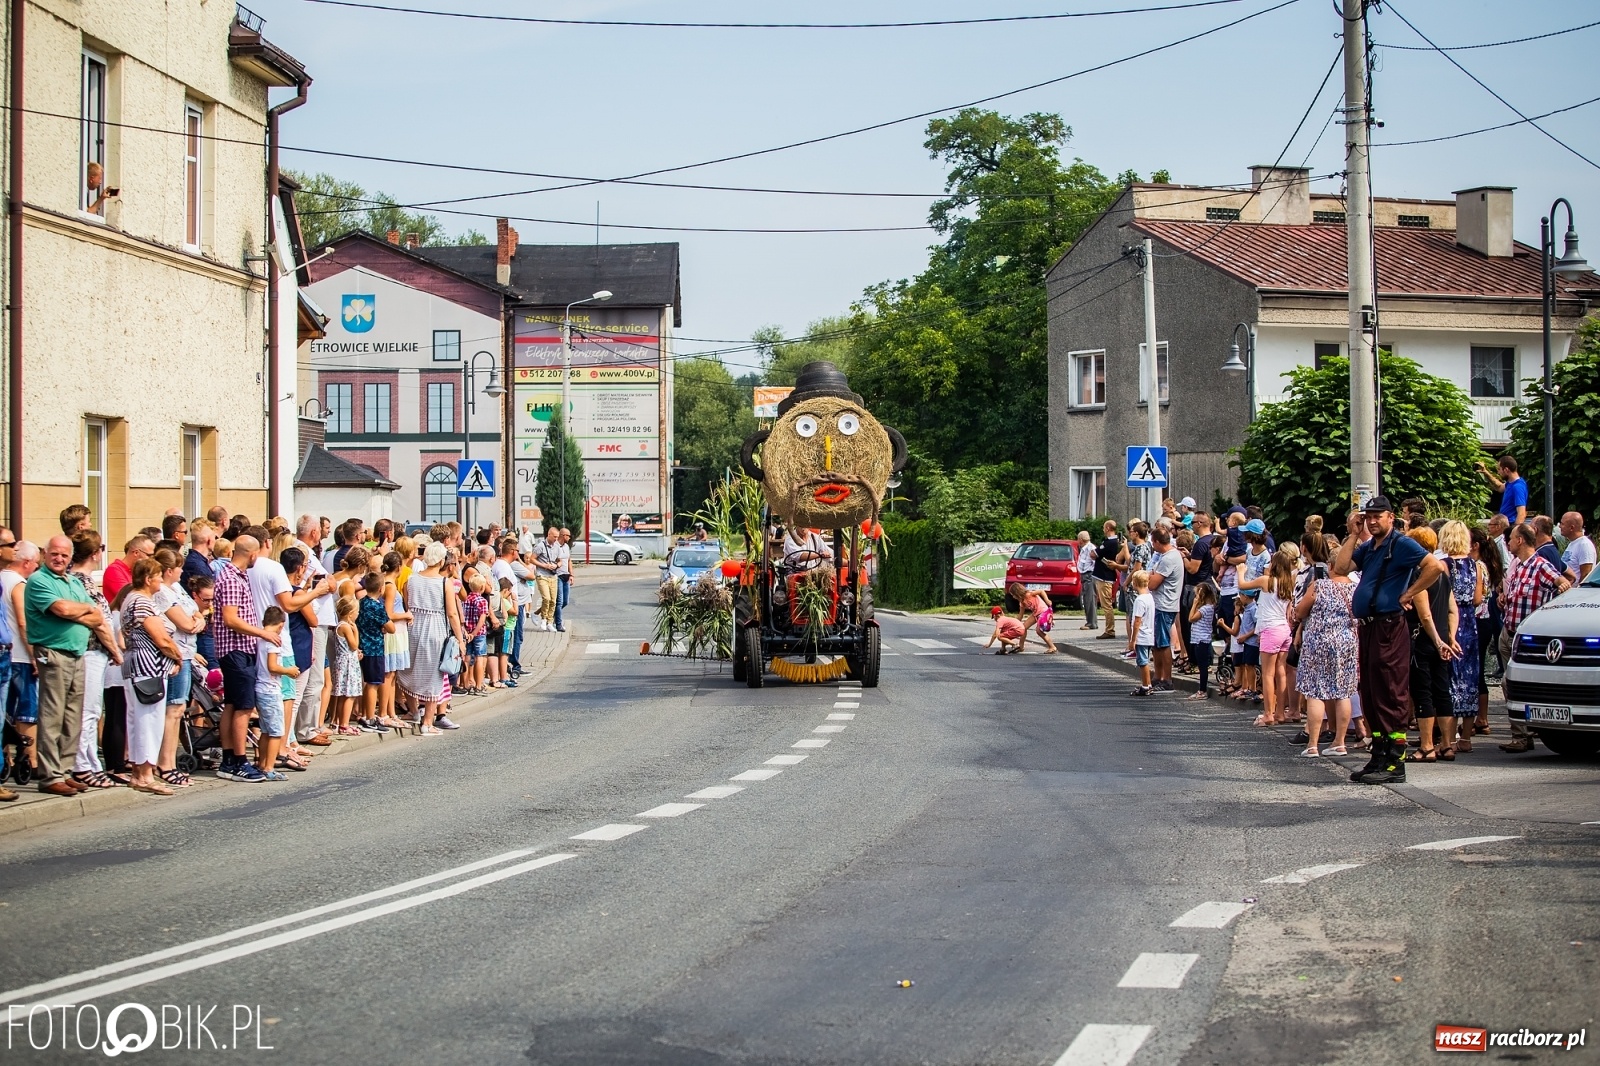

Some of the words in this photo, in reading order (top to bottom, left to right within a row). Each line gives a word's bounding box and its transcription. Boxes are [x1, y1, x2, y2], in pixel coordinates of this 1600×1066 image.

[559, 324, 649, 333] ektro-service
[310, 342, 369, 352] ETROWICE
[372, 342, 418, 352] WIELKIE
[613, 346, 649, 359] kontaktu
[599, 370, 656, 379] www.400V.pl
[598, 444, 622, 452] FMC
[964, 562, 1004, 572] Ocieplanie
[1556, 708, 1569, 721] 319
